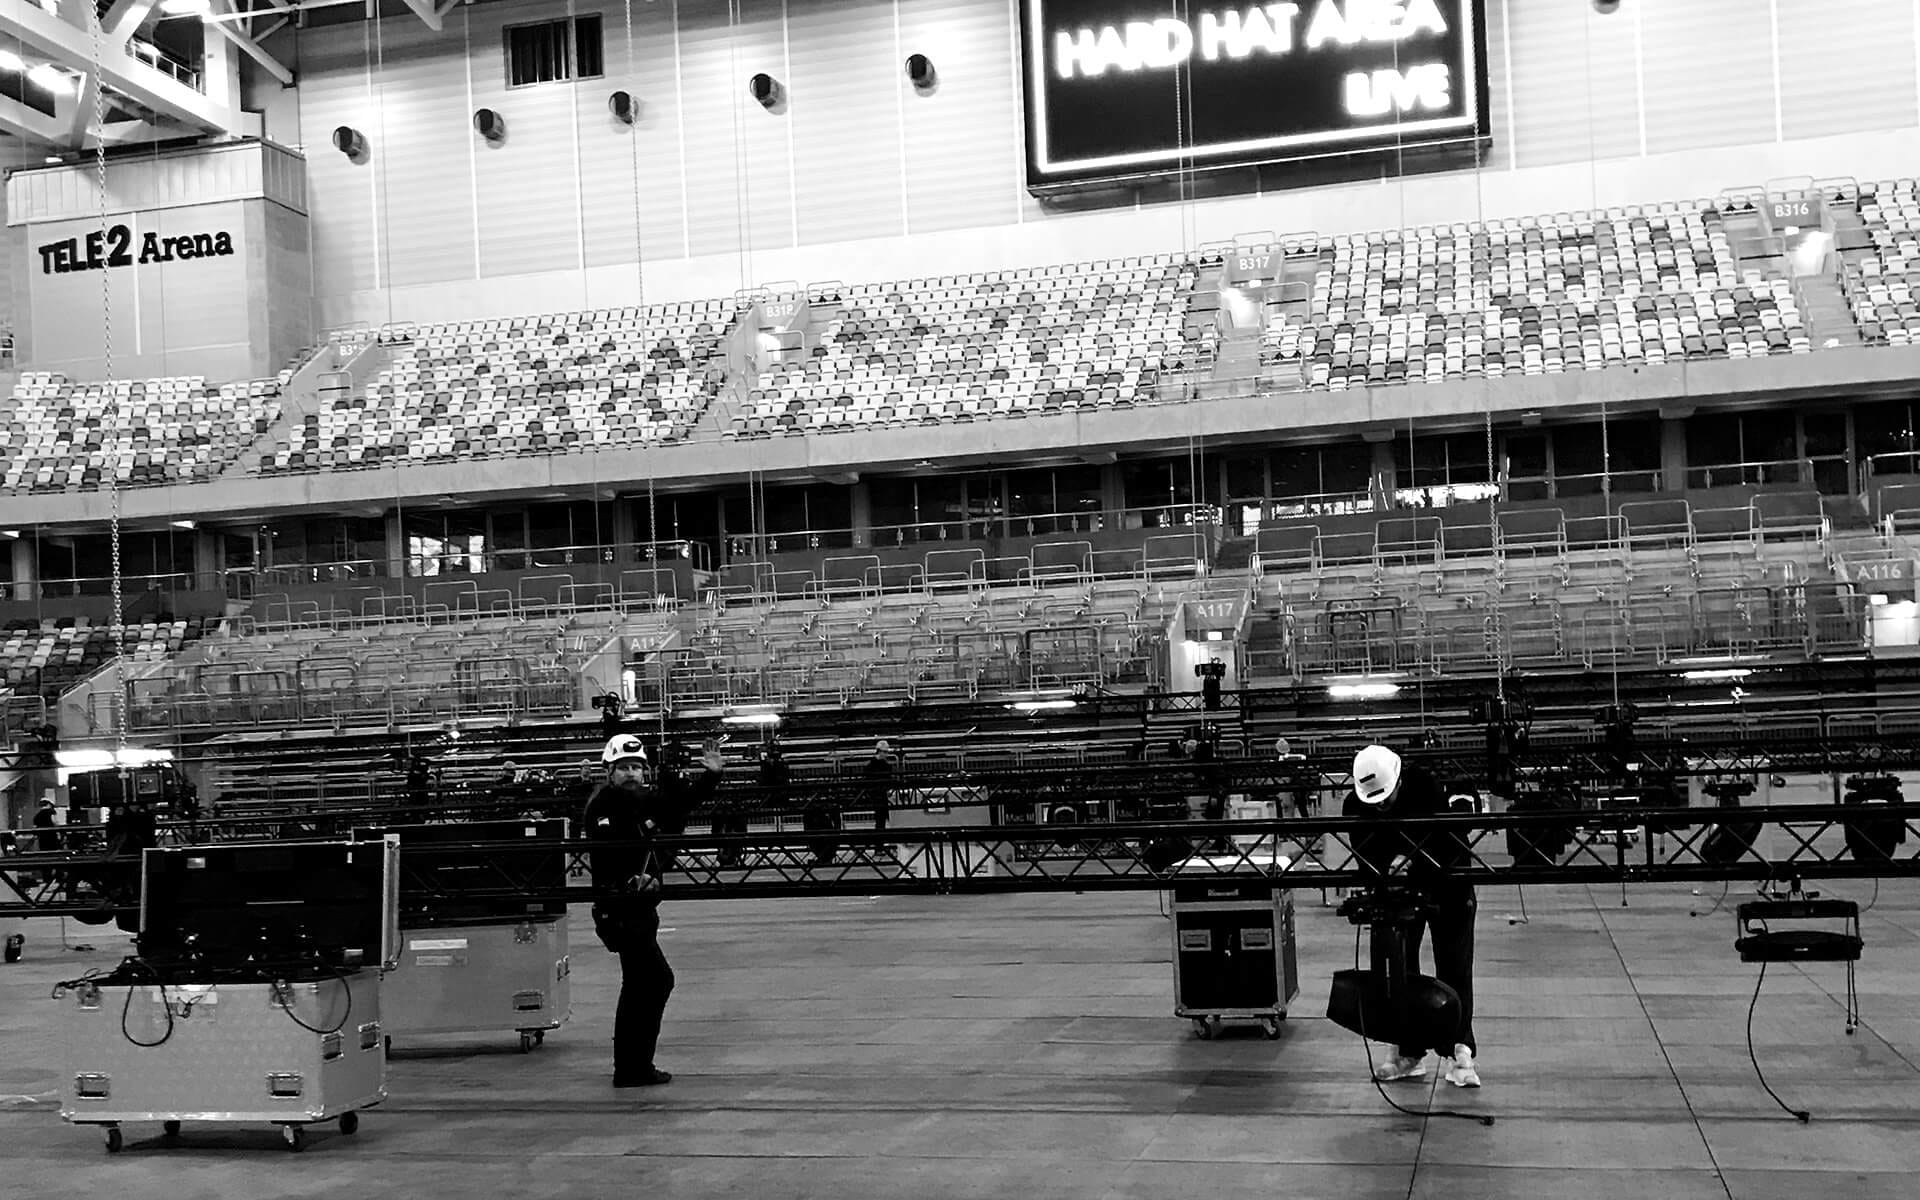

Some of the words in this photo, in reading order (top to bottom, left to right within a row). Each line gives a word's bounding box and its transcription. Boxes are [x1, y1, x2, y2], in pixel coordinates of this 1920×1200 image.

[1058, 19, 1193, 77] HARD
[1202, 3, 1298, 59] HAT
[1307, 0, 1447, 48] AREA
[1347, 63, 1450, 115] LIVE
[1774, 202, 1809, 218] B316
[38, 224, 132, 274] TELE2
[138, 231, 234, 264] Arena
[1240, 255, 1270, 270] B317
[1857, 563, 1902, 580] A116
[1198, 602, 1233, 618] A117
